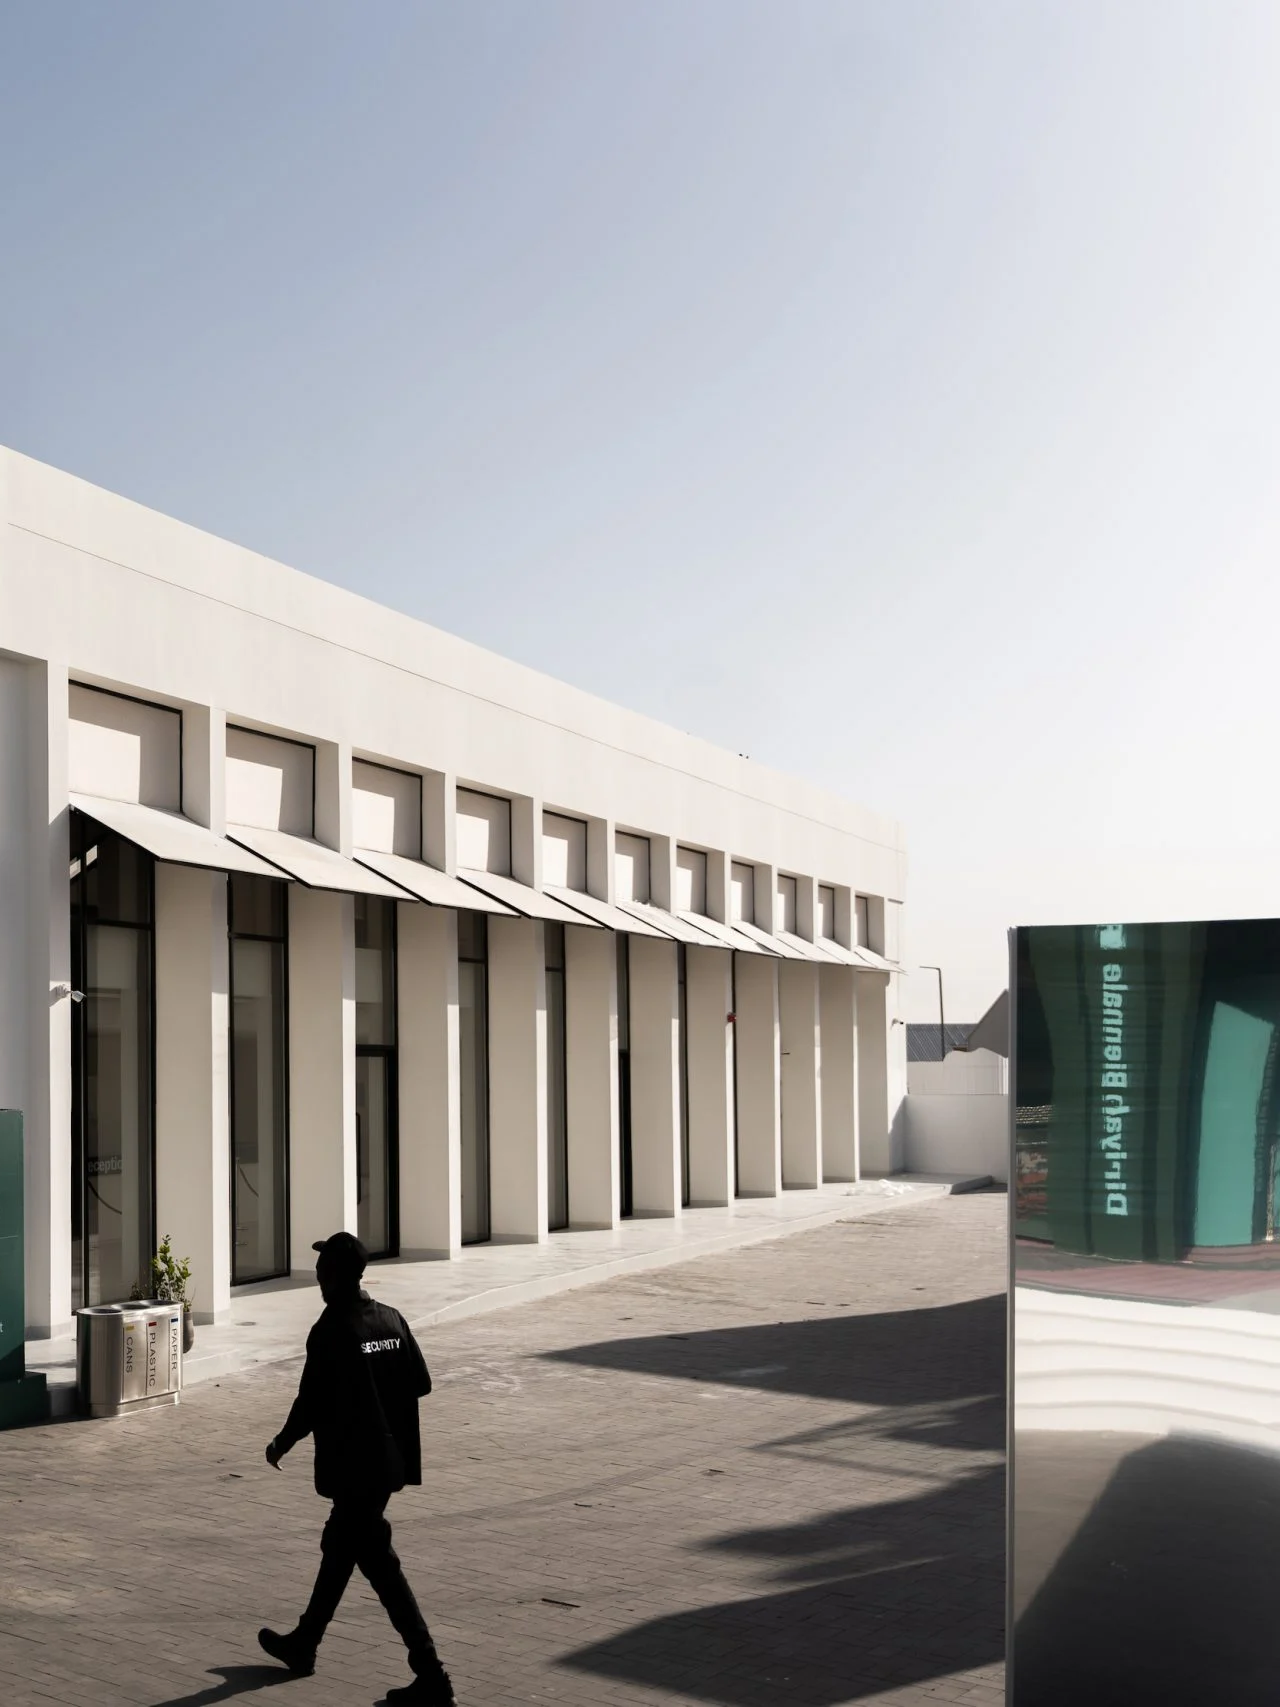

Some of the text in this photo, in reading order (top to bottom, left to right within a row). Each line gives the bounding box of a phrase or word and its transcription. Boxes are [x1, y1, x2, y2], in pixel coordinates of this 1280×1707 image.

[125, 1336, 134, 1374] CANS
[148, 1332, 156, 1387] PLASTIC
[361, 1338, 401, 1353] SECURITY
